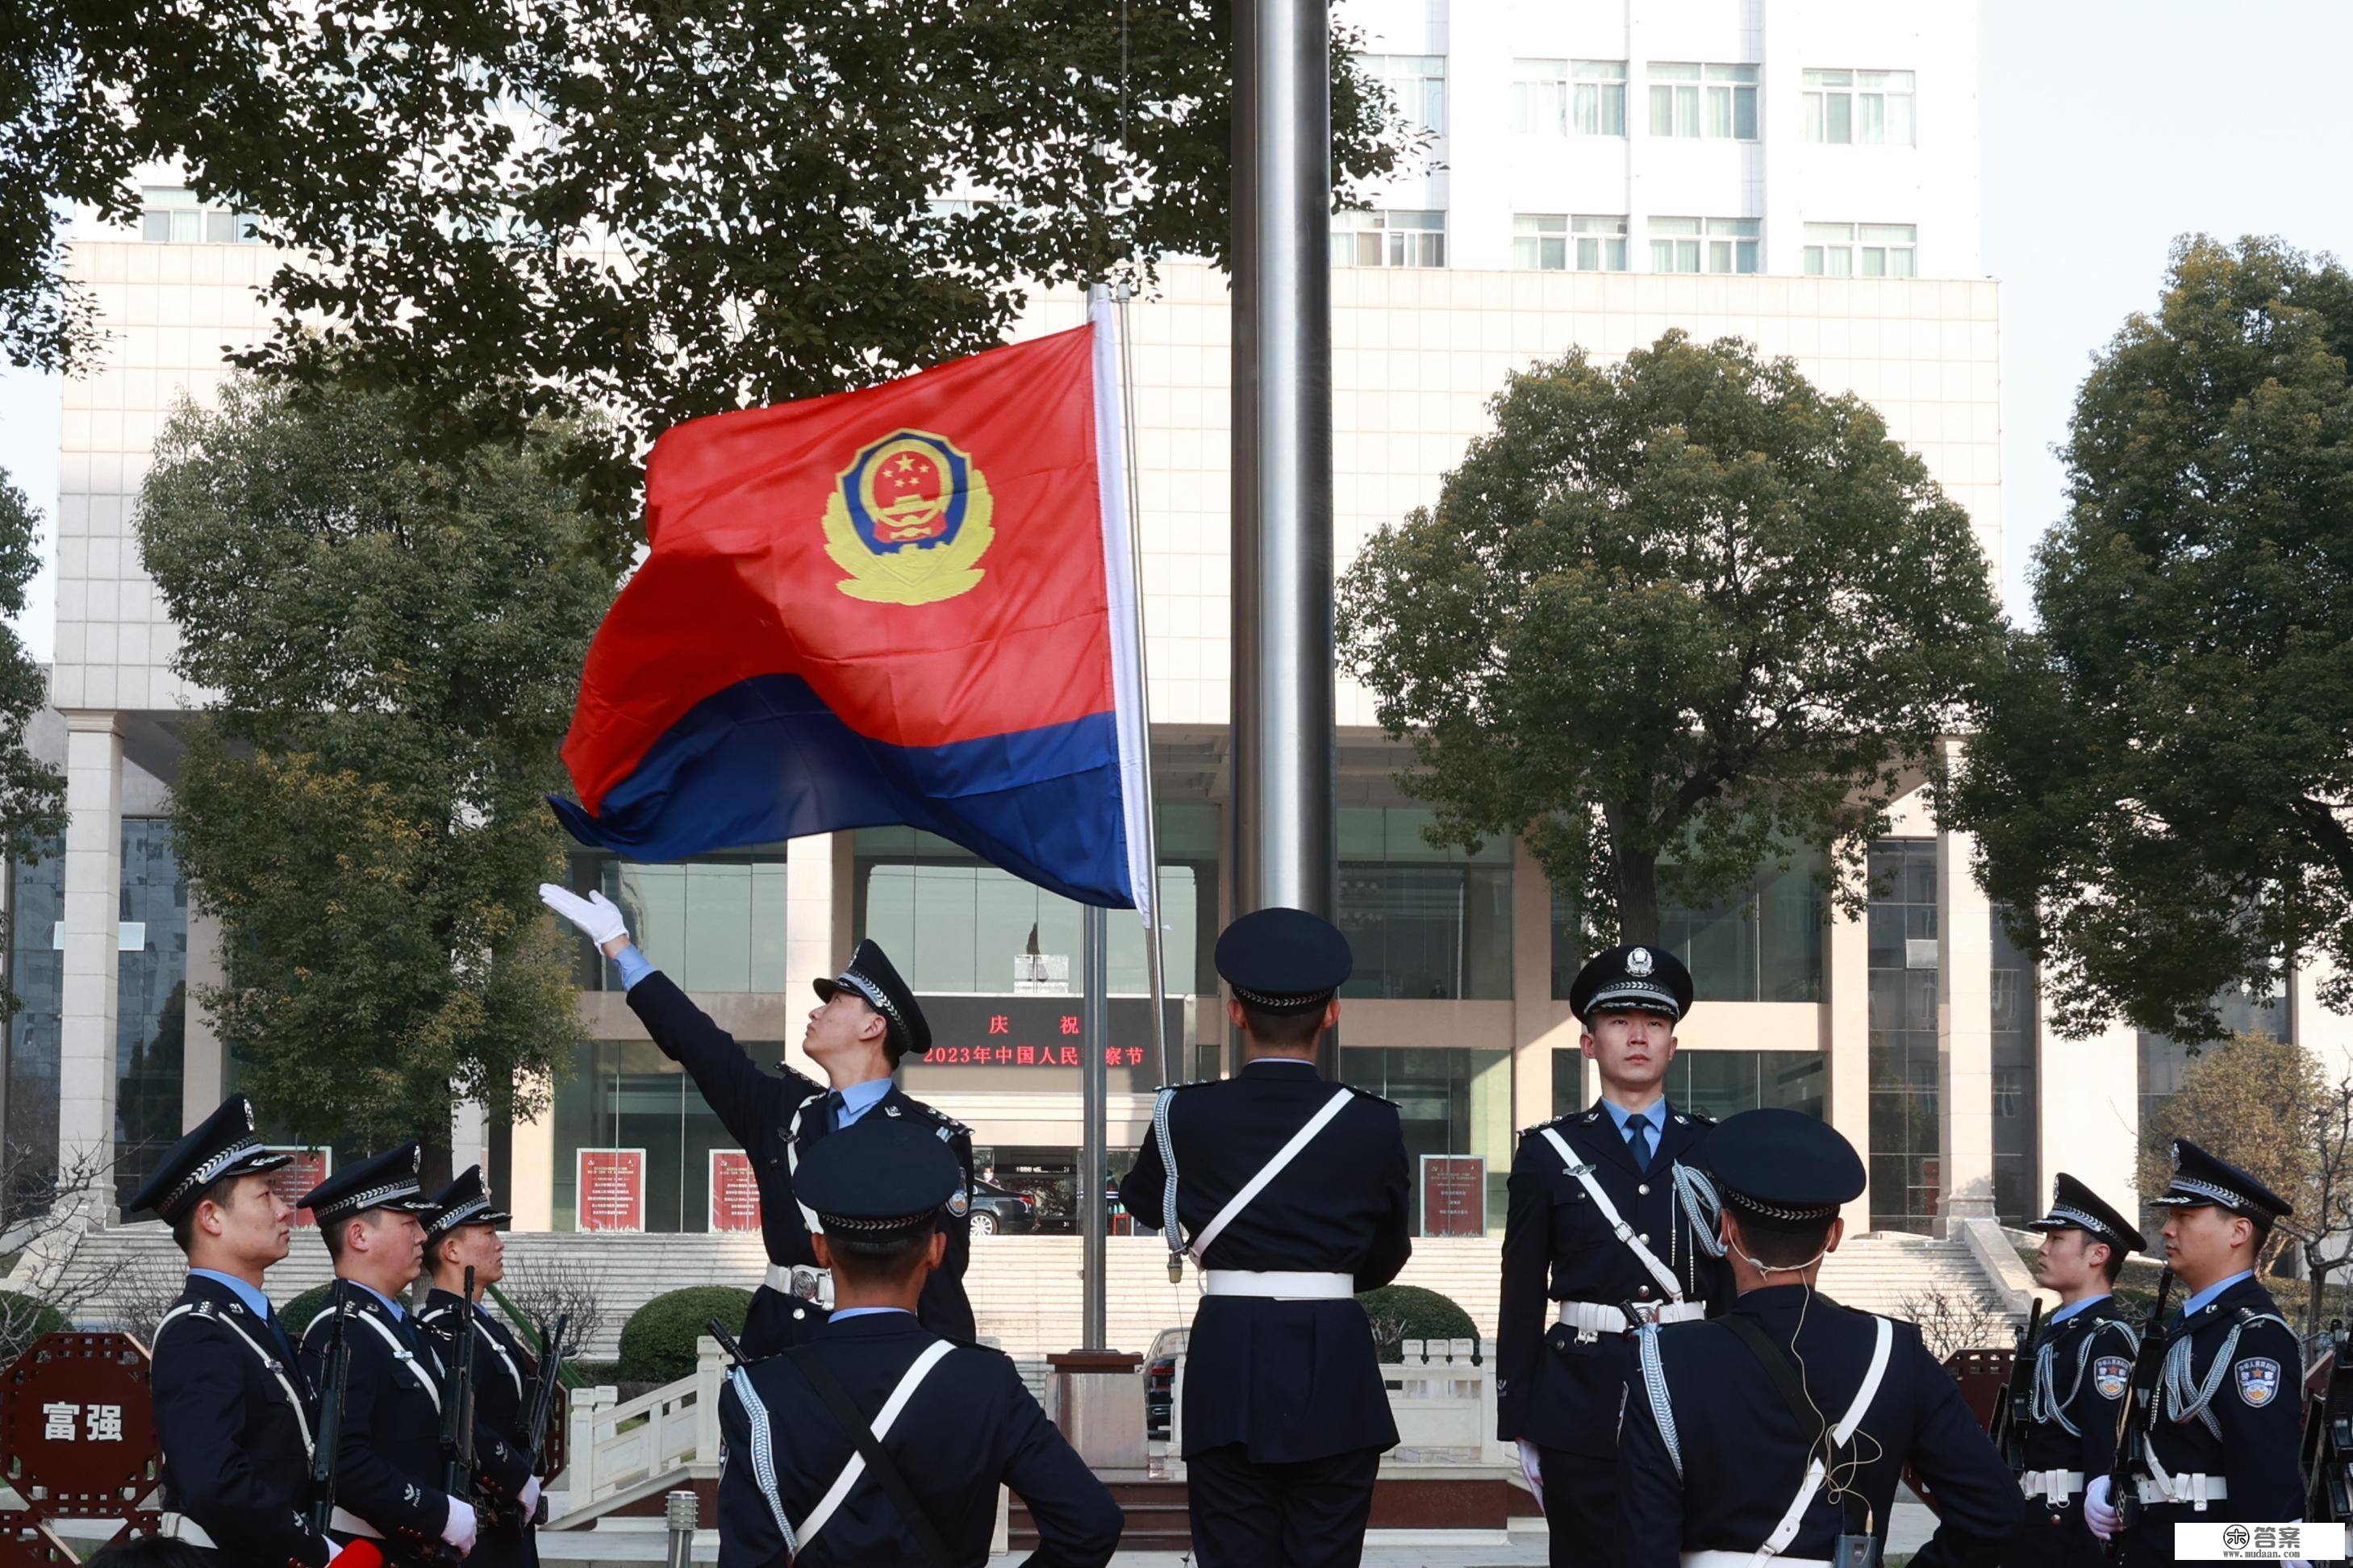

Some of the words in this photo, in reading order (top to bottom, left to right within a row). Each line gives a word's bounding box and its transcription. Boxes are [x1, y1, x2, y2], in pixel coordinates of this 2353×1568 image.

[989, 1015, 1008, 1034] 庆
[1060, 1015, 1079, 1035] 祝
[923, 1045, 1144, 1065] 2023年中国人民察节
[43, 1401, 123, 1441] 富强
